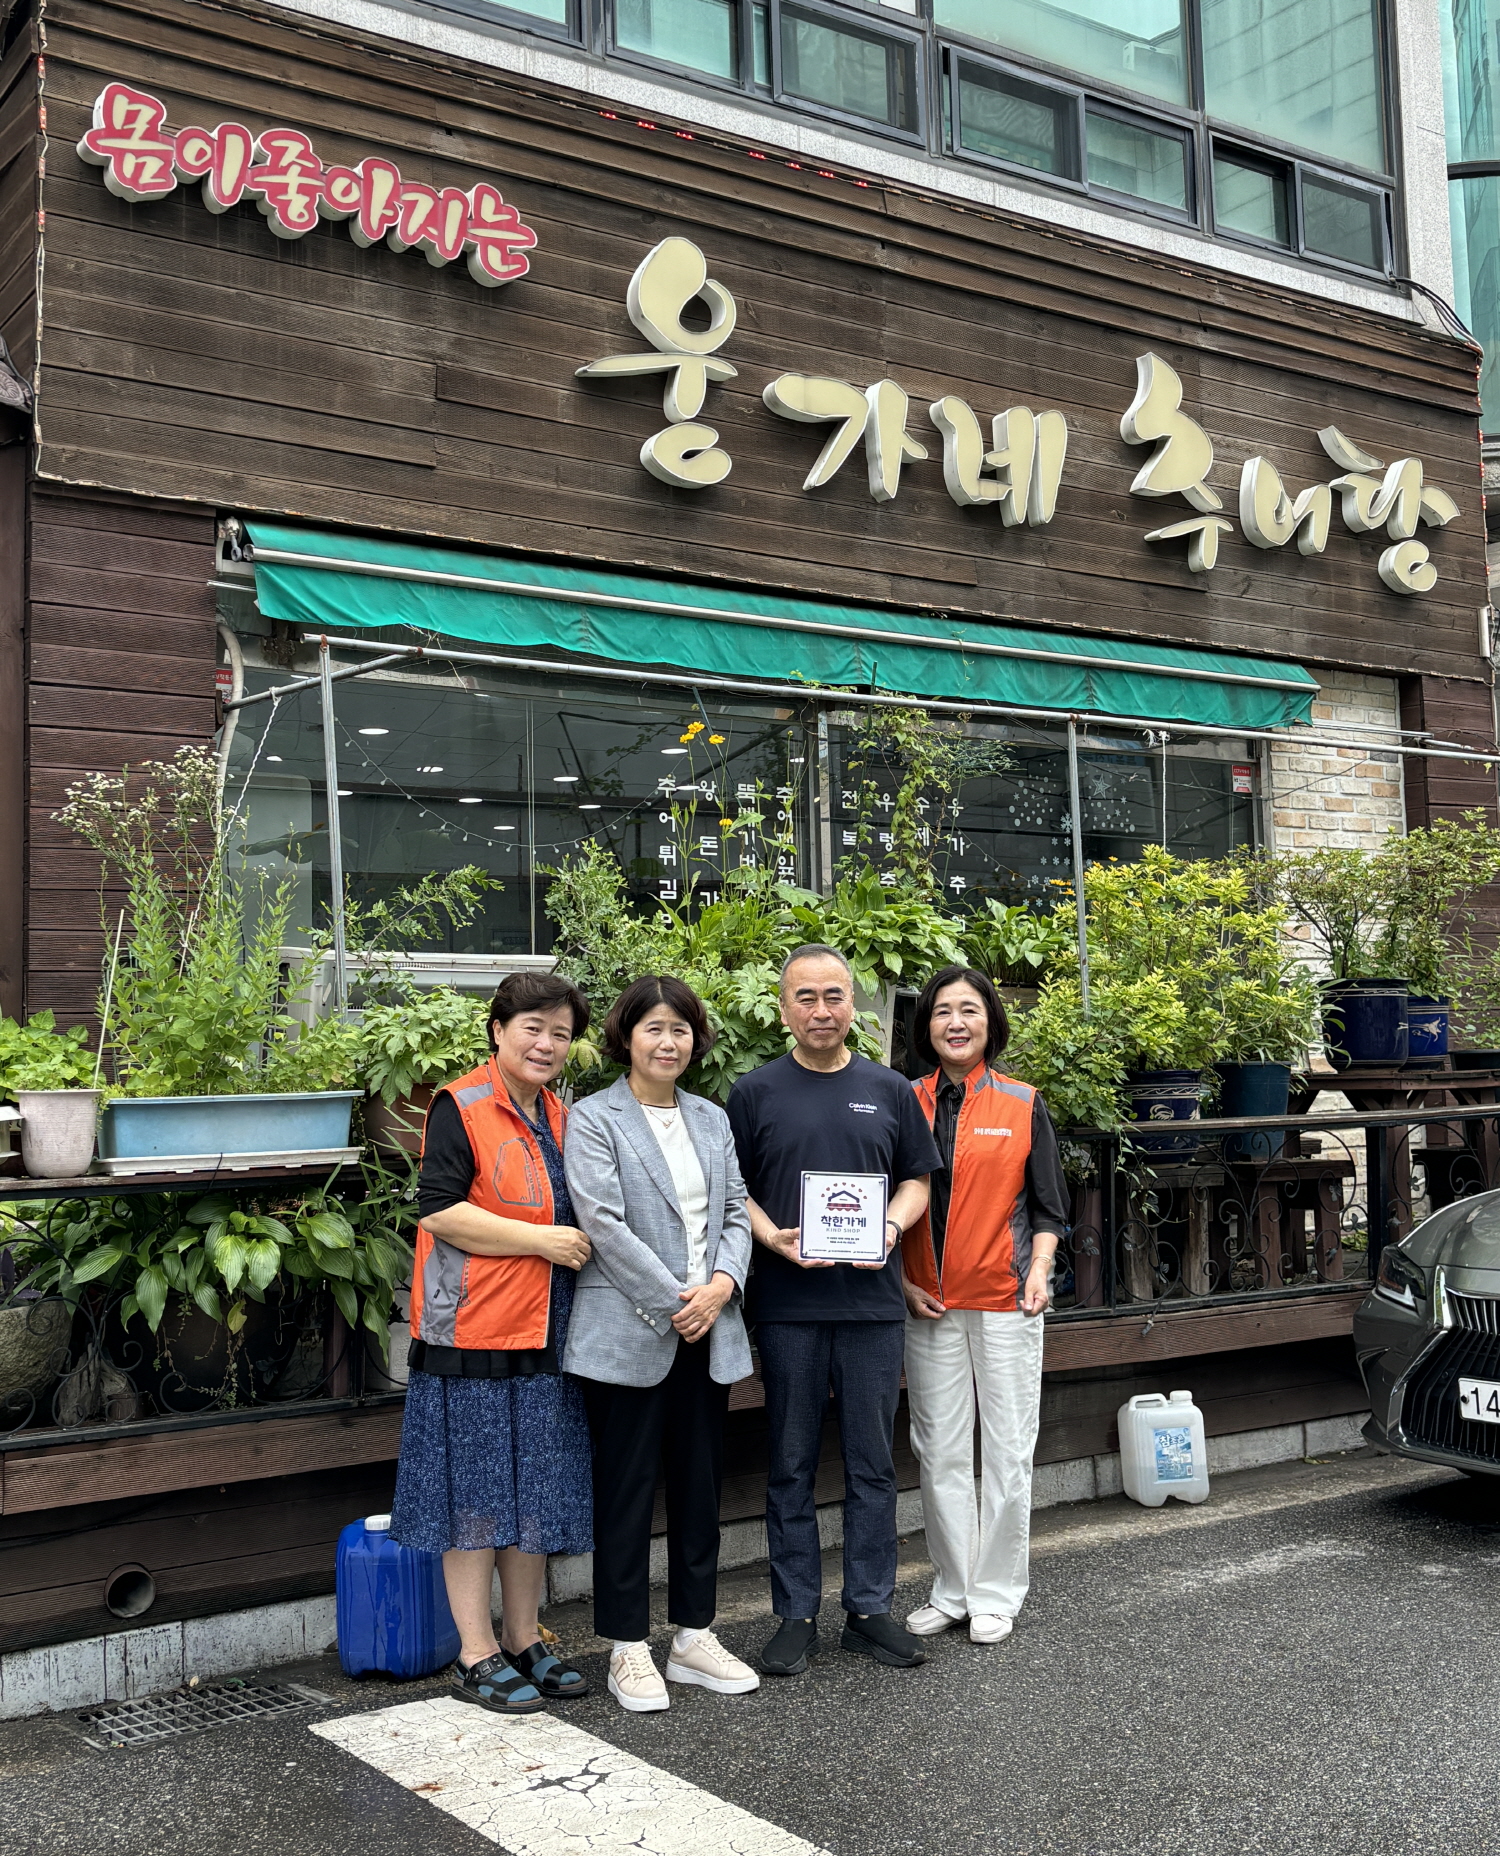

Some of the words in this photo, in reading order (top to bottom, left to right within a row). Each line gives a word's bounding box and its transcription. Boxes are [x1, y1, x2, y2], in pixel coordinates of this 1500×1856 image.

[574, 236, 1068, 527] 웅가네
[1120, 352, 1461, 595] 추어탕
[820, 1215, 867, 1228] 착한가게
